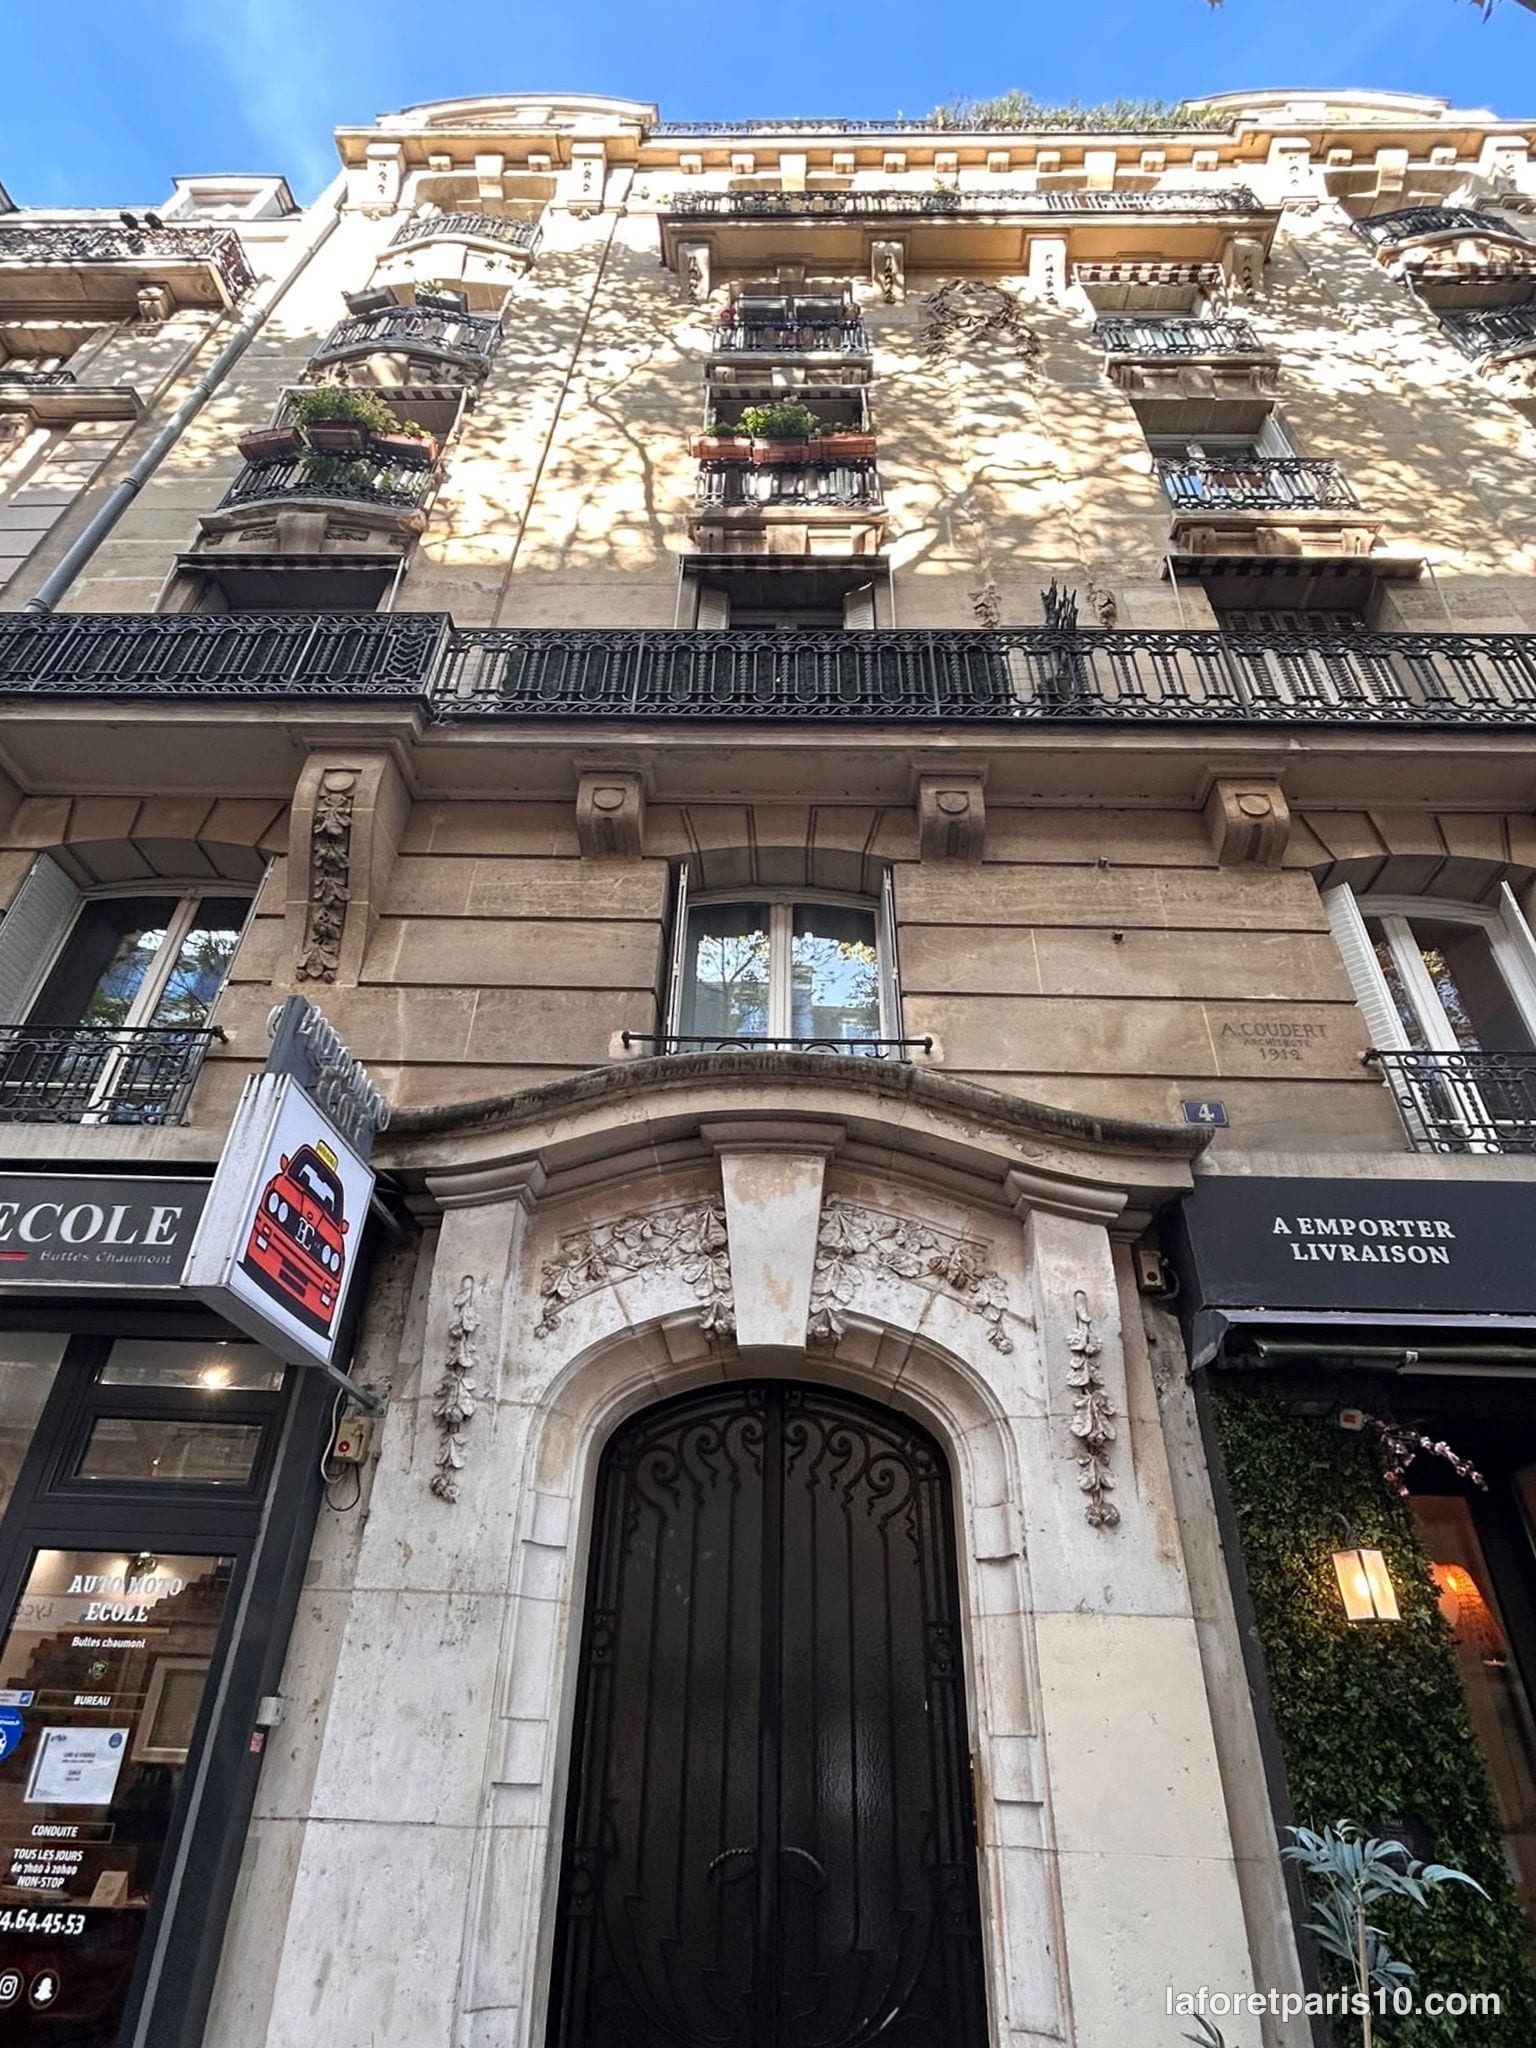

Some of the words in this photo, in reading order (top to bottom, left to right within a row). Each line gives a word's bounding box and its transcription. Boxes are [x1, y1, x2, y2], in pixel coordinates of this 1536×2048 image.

[1260, 1048, 1304, 1060] 1912
[1198, 1103, 1215, 1122] 4
[1272, 1217, 1291, 1235] A
[1297, 1218, 1456, 1238] EMPORTER
[40, 1250, 89, 1262] Buttes
[95, 1252, 172, 1265] Chaumont
[1291, 1243, 1450, 1264] LIVRAISON
[67, 1575, 122, 1594] AUTO
[126, 1576, 183, 1597] MOTO
[84, 1602, 149, 1622] ECOLE
[71, 1636, 101, 1648] Buttes
[102, 1637, 146, 1649] chaumont
[73, 1695, 111, 1706] BUREAU
[31, 1824, 79, 1838] CONDUITE
[13, 1848, 38, 1860] TOUS
[37, 1849, 55, 1861] LES
[54, 1850, 84, 1862] JOURS
[10, 1861, 22, 1873] de
[17, 1875, 65, 1888] NON-STOP
[0, 1908, 86, 1935] 4.64.45.53
